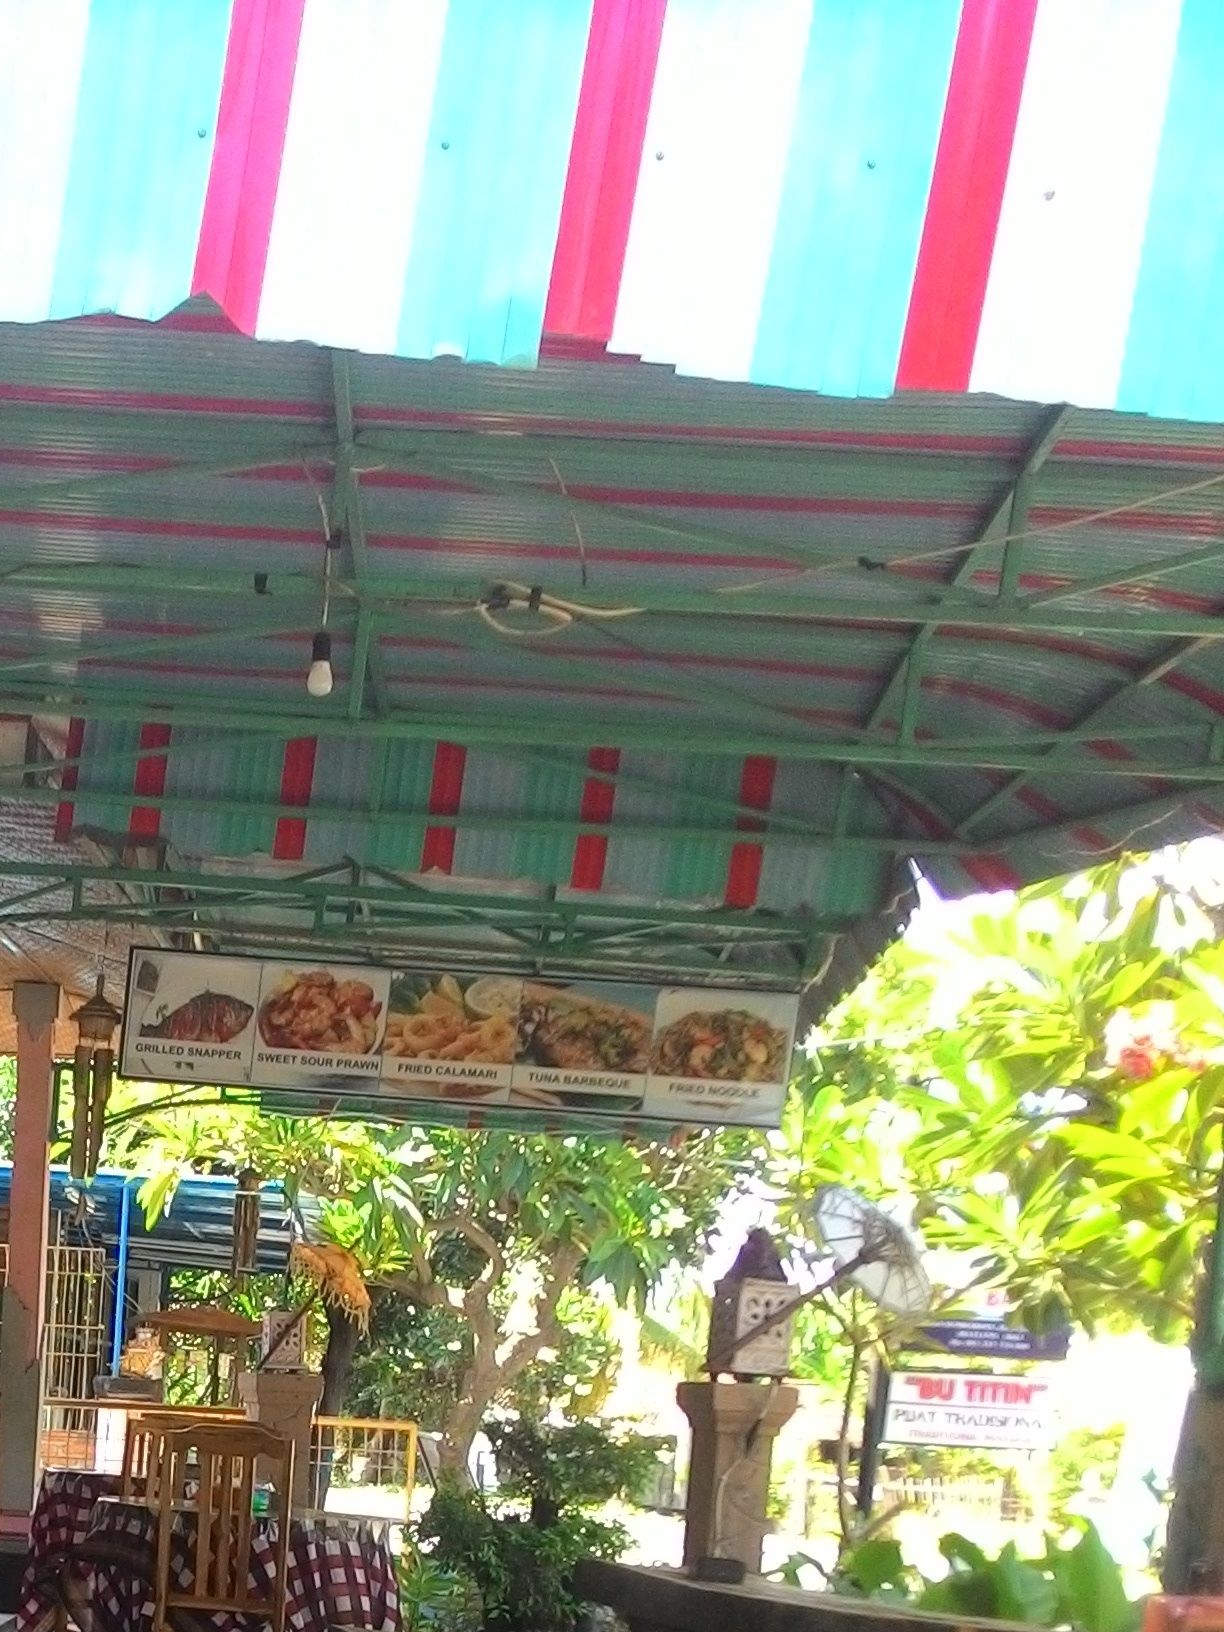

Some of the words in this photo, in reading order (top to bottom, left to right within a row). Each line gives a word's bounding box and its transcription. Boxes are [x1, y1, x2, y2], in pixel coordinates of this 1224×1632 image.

[135, 1043, 184, 1056] GRILLED
[187, 1047, 242, 1060] SNAPPER
[257, 1052, 297, 1065] SWEET
[300, 1055, 333, 1068] SOUR
[336, 1058, 380, 1072] PRAWN
[397, 1063, 432, 1075] FRIED
[435, 1065, 498, 1080] CALAMARI
[528, 1071, 560, 1084] TUNA
[563, 1074, 631, 1089] BARBEQUE
[669, 1082, 704, 1096] FRIED
[708, 1085, 760, 1099] NOODLE
